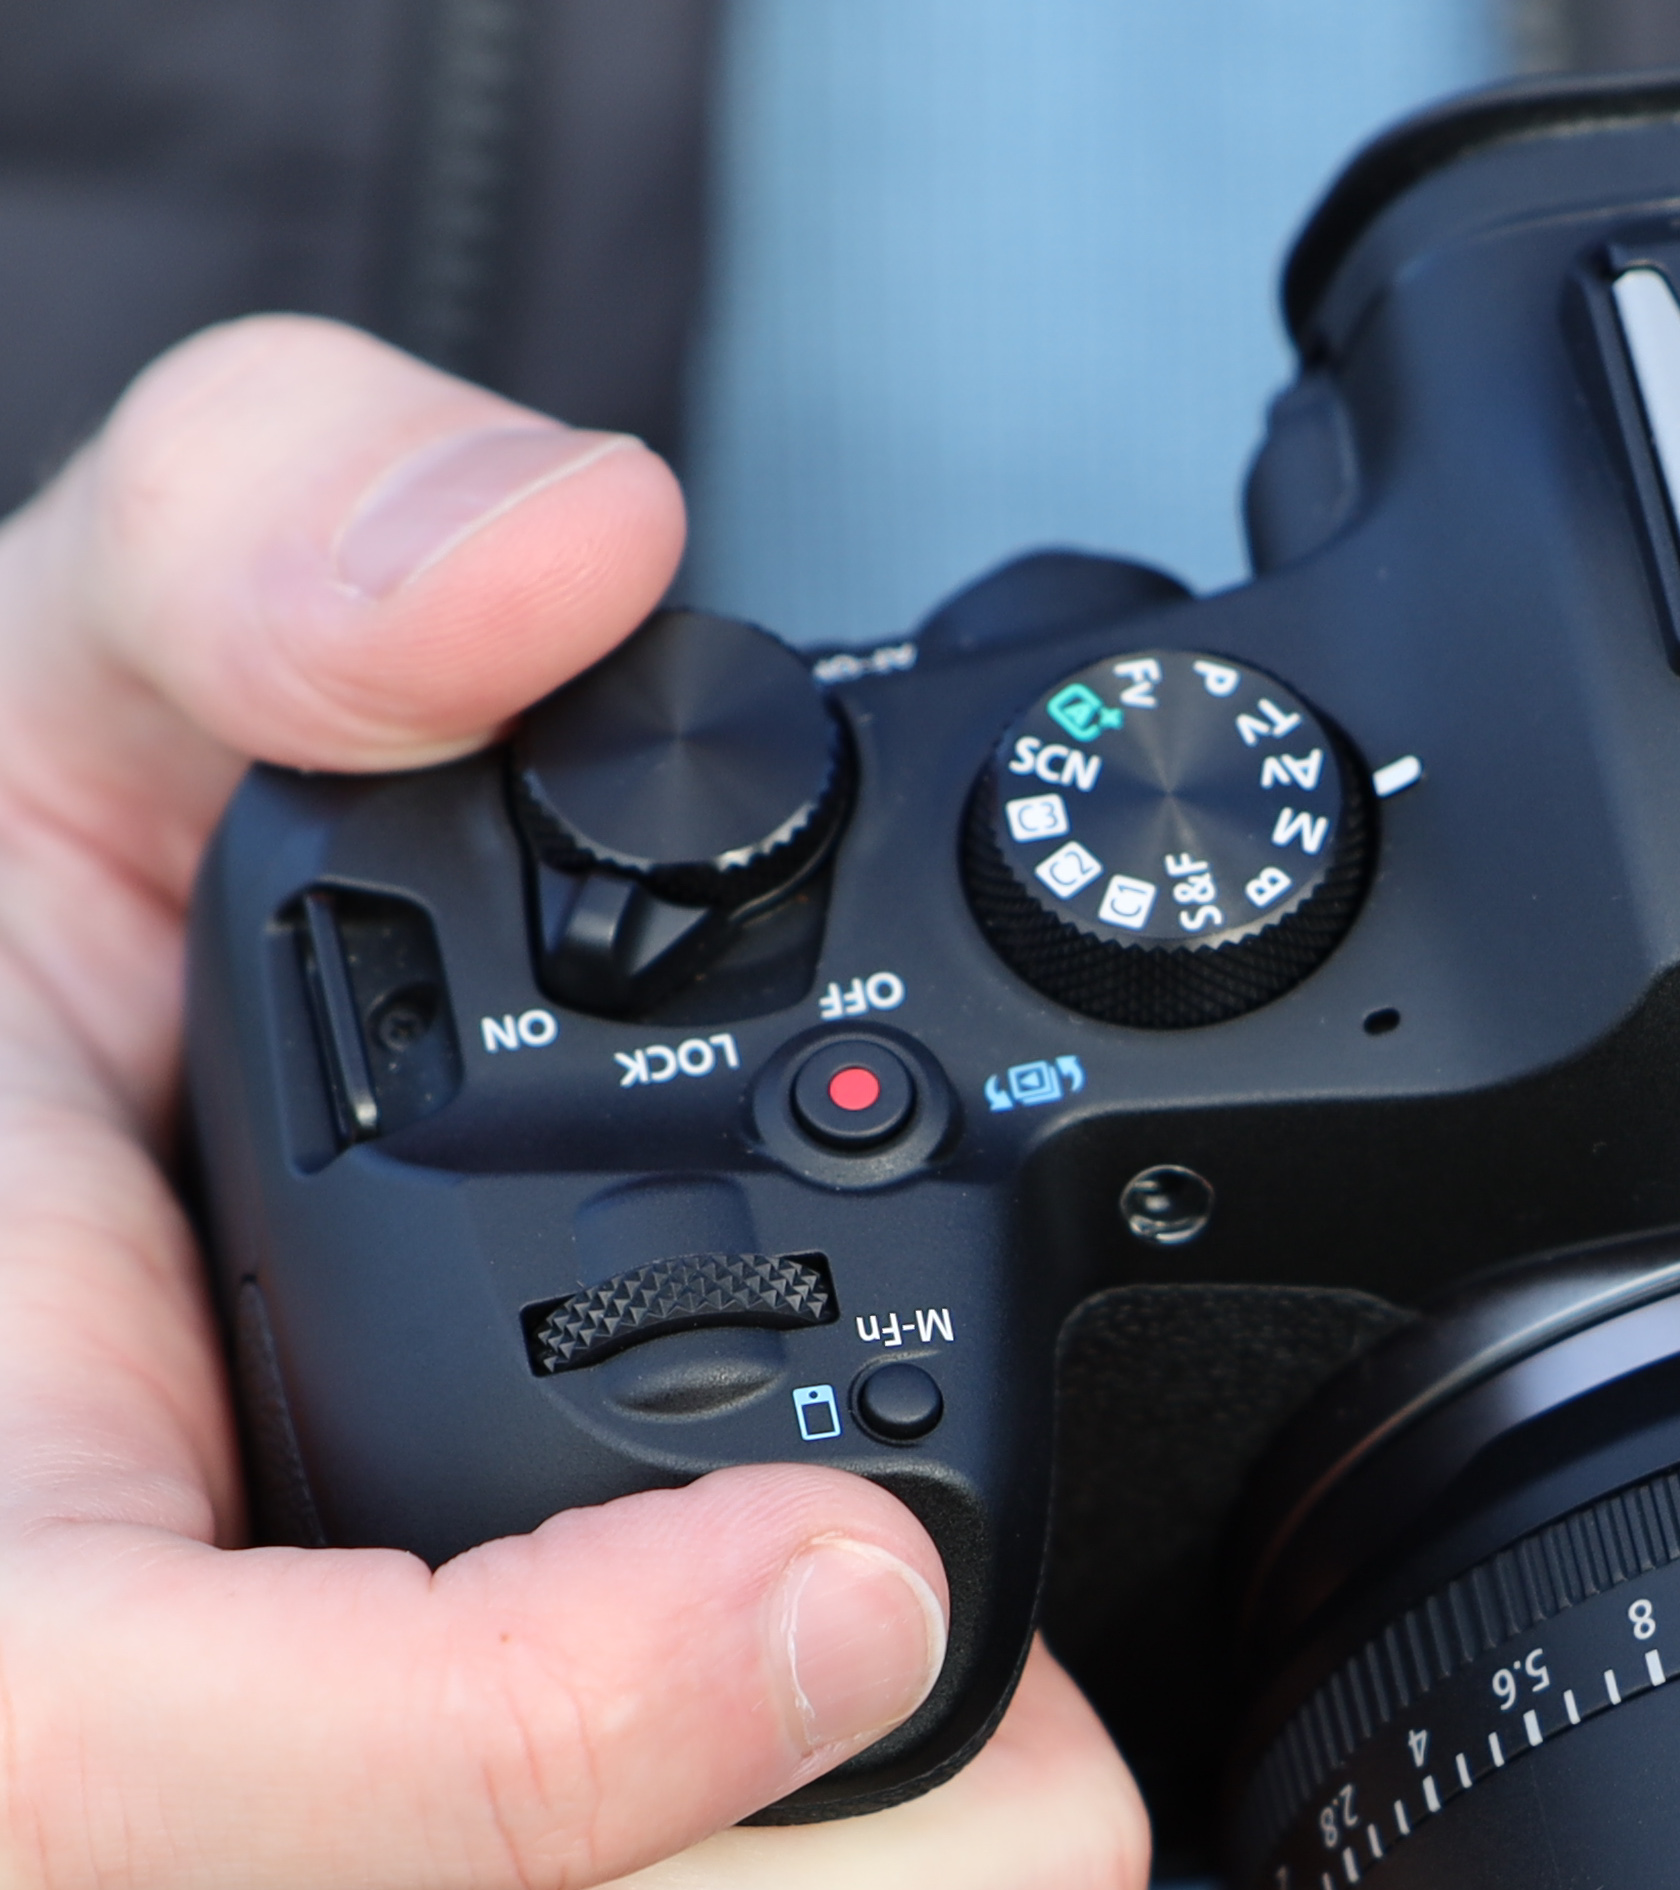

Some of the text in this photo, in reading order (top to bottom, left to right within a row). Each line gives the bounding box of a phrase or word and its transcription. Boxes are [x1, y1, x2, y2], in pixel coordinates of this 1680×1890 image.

[1114, 659, 1160, 706] Fv
[1194, 661, 1237, 694] P
[1237, 699, 1300, 744] Tv
[1010, 737, 1100, 791] SCN
[1262, 749, 1321, 788] Av
[1273, 808, 1327, 852] M
[1166, 853, 1223, 929] S&F
[1246, 868, 1291, 905] B
[820, 972, 904, 1018] OFF
[482, 1010, 556, 1050] ON
[615, 1034, 738, 1085] LOCK
[857, 1309, 953, 1346] M-Fn
[1629, 1599, 1656, 1639] 8
[1493, 1649, 1550, 1710] 5.6
[1409, 1730, 1427, 1766] 4
[1321, 1784, 1358, 1847] 2.8
